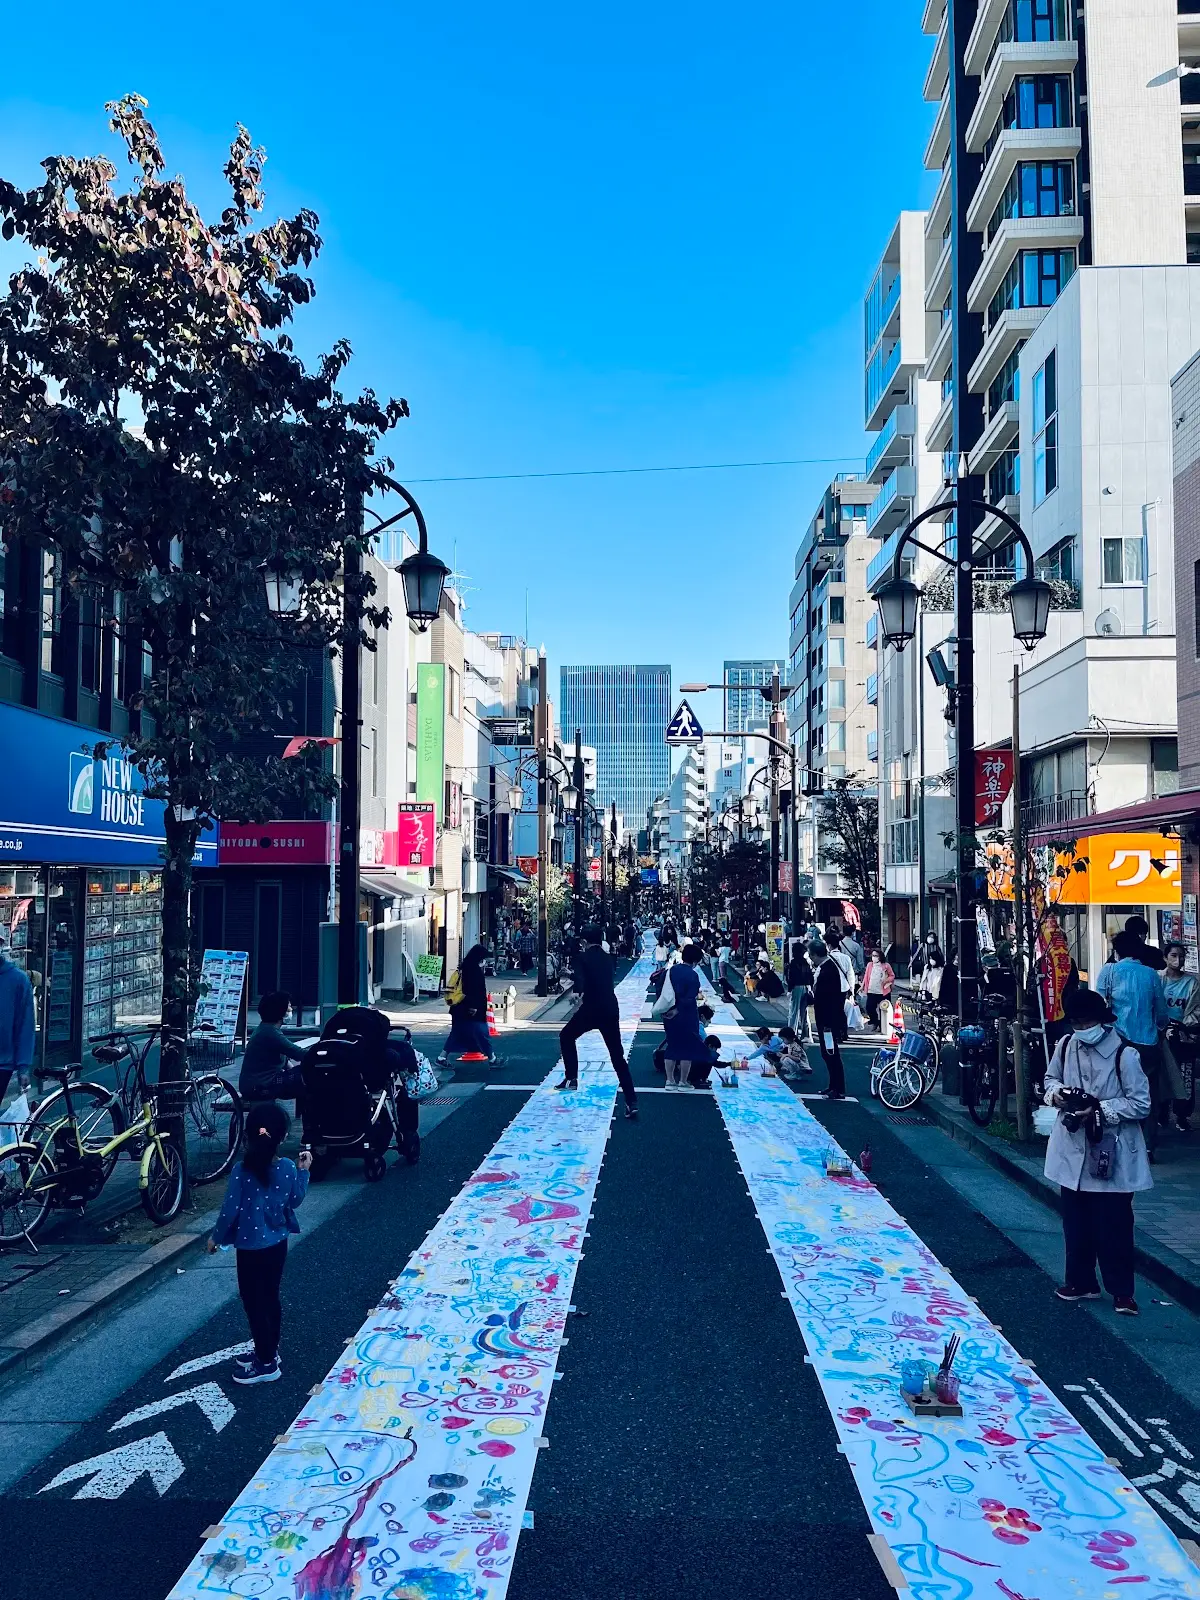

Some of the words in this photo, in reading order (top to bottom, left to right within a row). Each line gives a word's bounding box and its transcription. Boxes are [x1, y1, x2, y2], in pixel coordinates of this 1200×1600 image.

[424, 717, 433, 762] DAHLIAS
[102, 757, 132, 791] NEW
[101, 789, 145, 826] HOUSE
[273, 838, 305, 848] SUSHI
